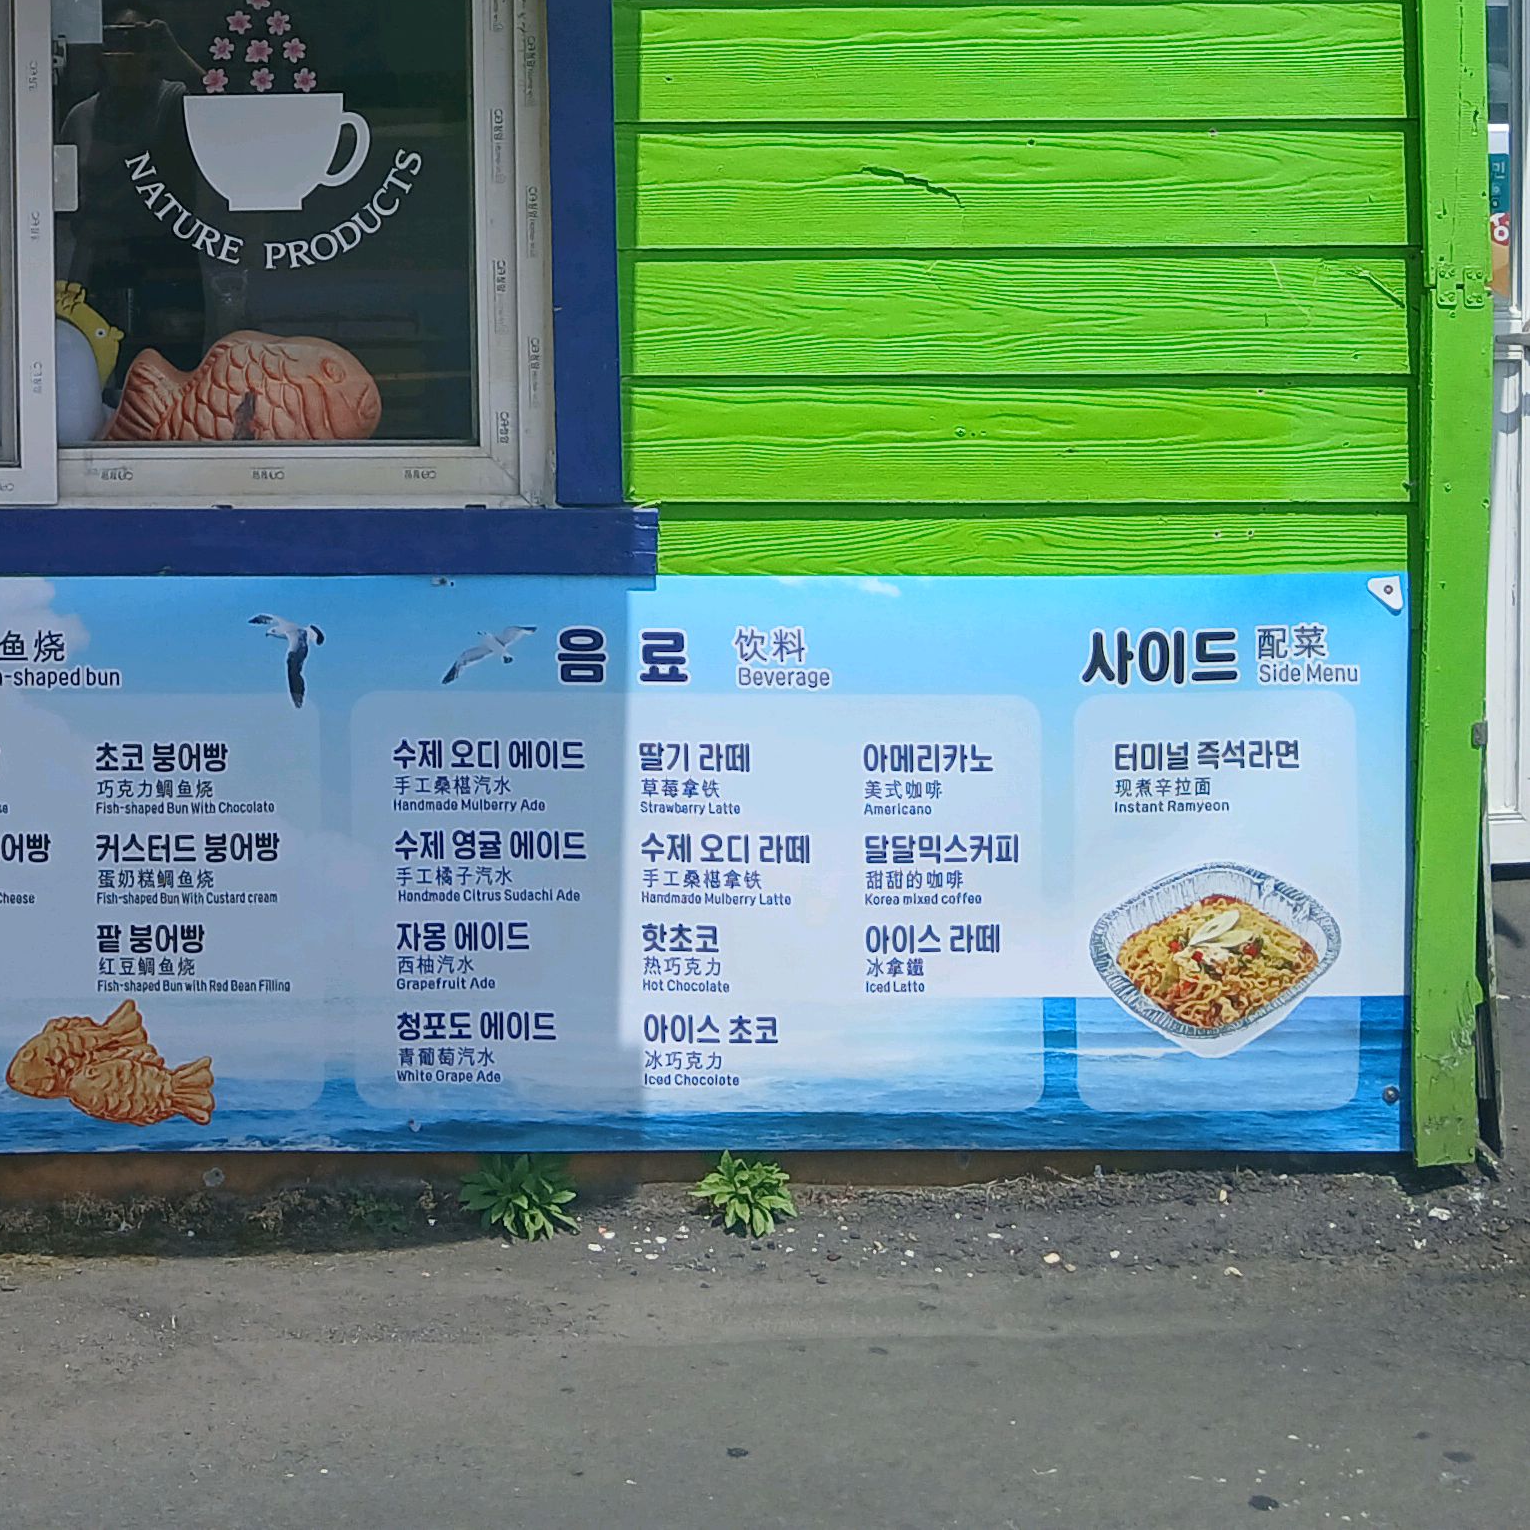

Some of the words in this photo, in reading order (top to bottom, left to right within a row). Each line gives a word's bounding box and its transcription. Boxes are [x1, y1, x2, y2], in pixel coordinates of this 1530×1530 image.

[124, 150, 244, 265] NATURE
[264, 148, 422, 269] PRODUCTS
[735, 628, 805, 662] 饮料
[1257, 626, 1326, 658] 配菜
[1082, 631, 1238, 684] 사이드
[87, 668, 120, 686] bun
[739, 668, 830, 688] Beverage
[1259, 664, 1301, 683] Side
[1307, 664, 1359, 683] Menu
[96, 742, 144, 772] 초코
[153, 742, 228, 772] 붕어빵
[393, 739, 442, 769] 수제
[451, 739, 499, 769] 오디
[509, 739, 585, 769] 에이드
[639, 742, 688, 772] 딸기
[699, 742, 749, 772] 라떼
[864, 744, 993, 773] 아메리카노
[1114, 740, 1188, 770] 터미널
[1197, 740, 1300, 770] 즉석라면
[98, 780, 213, 798] 巧克力鲷鱼烧
[864, 780, 942, 799] 美式咖啡
[1114, 778, 1211, 798] 现煮辛拉面
[96, 802, 164, 815] Fish-shaped
[167, 802, 188, 815] Bun
[191, 802, 215, 815] With
[219, 802, 274, 815] Chocolate
[394, 800, 458, 812] Handmade
[461, 800, 517, 812] Mulberry
[521, 800, 545, 812] Ade
[640, 801, 705, 815] Strawberry
[708, 801, 740, 815] Latte
[864, 803, 932, 815] Americano
[1114, 801, 1164, 813] Instant
[1168, 801, 1229, 813] Ramyeon
[96, 833, 196, 862] 커스터드
[205, 833, 279, 862] 붕어빵
[395, 830, 444, 860] 수제
[452, 830, 501, 860] 영귤
[510, 830, 586, 860] 에이드
[641, 833, 691, 863] 수제
[700, 833, 749, 863] 오디
[759, 833, 810, 863] 라떼
[865, 834, 1019, 864] 달달믹스커피
[98, 870, 214, 888] 蛋奶糕鲷鱼烧
[396, 866, 513, 886] 手工橘子汽水
[866, 870, 963, 890] 甜甜的咖啡
[97, 892, 157, 905] Fish-shaped
[161, 892, 179, 905] Bun
[182, 892, 203, 905] With
[207, 892, 245, 905] Custard
[248, 892, 277, 905] cream
[398, 890, 460, 902] Handmade
[463, 890, 501, 902] Citrus
[504, 890, 553, 902] Sudachi
[556, 890, 580, 902] Ade
[641, 892, 701, 906] Handmade
[705, 892, 756, 906] Mulberry
[760, 892, 791, 906] Latte
[865, 894, 899, 905] Korea
[903, 894, 938, 905] mixed
[942, 894, 981, 905] coffee
[97, 924, 121, 953] 팥
[130, 924, 204, 953] 붕어빵
[397, 922, 446, 951] 자몽
[455, 922, 530, 951] 에이드
[642, 923, 719, 952] 핫초코
[865, 924, 941, 953] 아이스
[950, 924, 1000, 953] 라떼
[99, 957, 195, 976] 红豆鲷鱼烧
[397, 955, 474, 974] 西柚汽水
[643, 956, 721, 976] 热巧克力
[97, 980, 160, 993] Fish-shaped
[163, 980, 182, 993] Bun
[185, 980, 207, 993] with
[210, 980, 228, 993] Red
[231, 980, 256, 993] Bean
[259, 980, 290, 993] Filling
[397, 978, 466, 990] Grapefruit
[470, 978, 495, 990] Ade
[643, 979, 663, 992] Hot
[667, 979, 729, 992] Chocolate
[865, 981, 890, 993] Iced
[893, 981, 924, 993] Latte
[397, 1011, 472, 1041] 청포도
[480, 1011, 556, 1041] 에이드
[644, 1014, 720, 1044] 아이스
[729, 1014, 778, 1044] 초코
[645, 1050, 722, 1070] 冰巧克力
[397, 1070, 432, 1083] White
[436, 1070, 473, 1083] Grape
[476, 1070, 500, 1083] Ade
[644, 1074, 671, 1086] Iced
[675, 1074, 739, 1086] Chocolate
